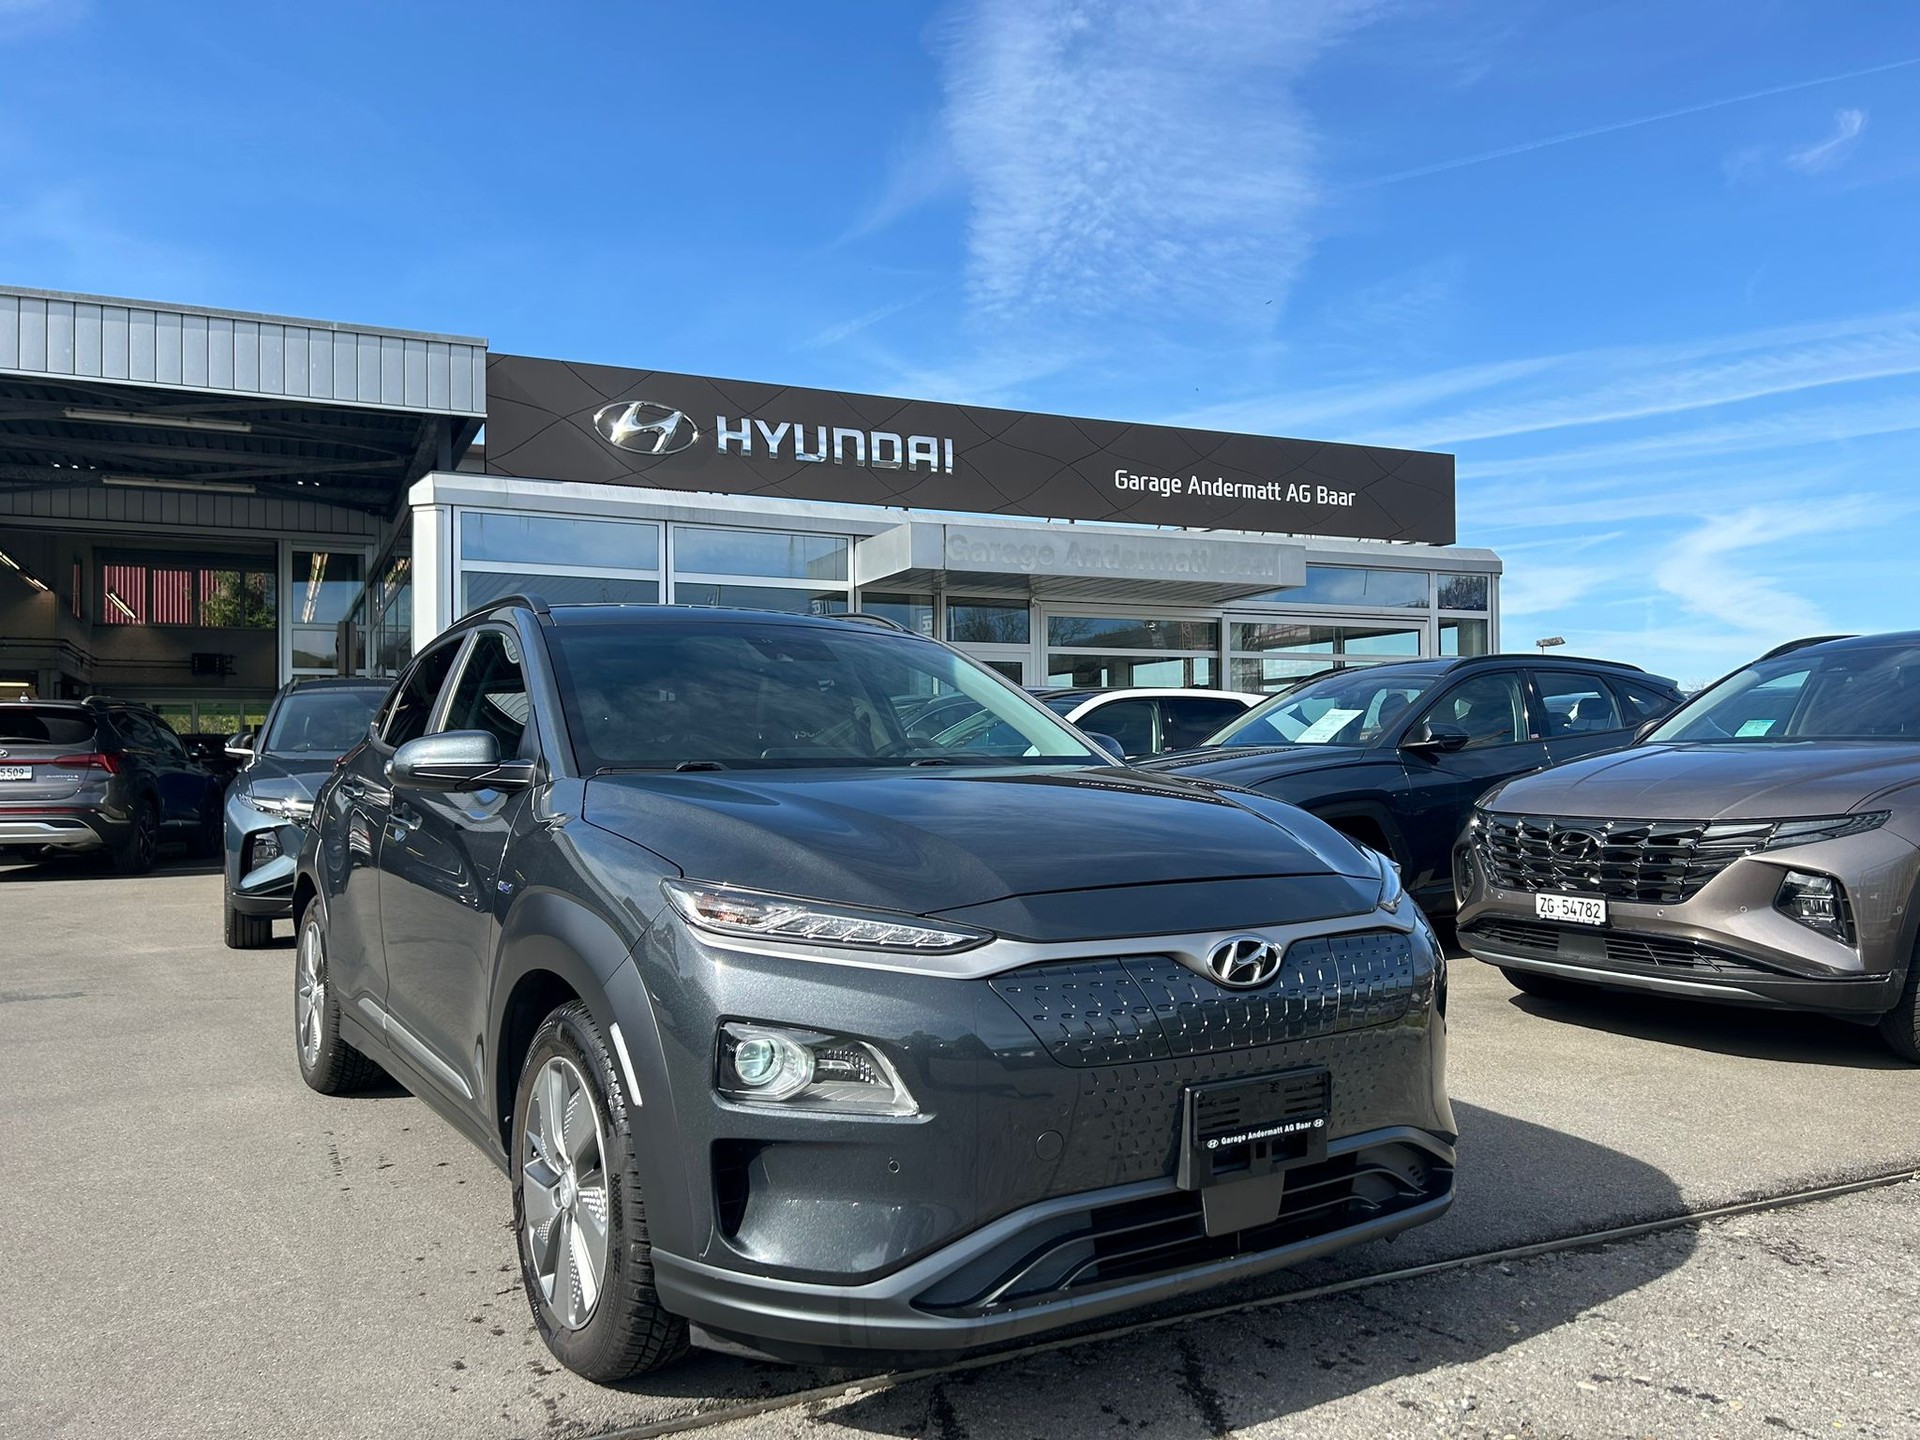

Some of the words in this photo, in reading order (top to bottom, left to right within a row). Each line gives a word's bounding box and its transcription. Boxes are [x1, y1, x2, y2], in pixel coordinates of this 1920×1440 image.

[716, 415, 953, 475] HYUNDAI
[1114, 469, 1182, 497] Garage
[1187, 475, 1282, 501] Andermatt
[1286, 483, 1311, 503] AG
[1316, 486, 1357, 506] Baar
[948, 533, 1056, 572] Garage
[1221, 1133, 1246, 1145] Garage
[1247, 1126, 1283, 1140] Andermatt
[1284, 1123, 1295, 1132] AG
[1296, 1121, 1312, 1130] Baar
